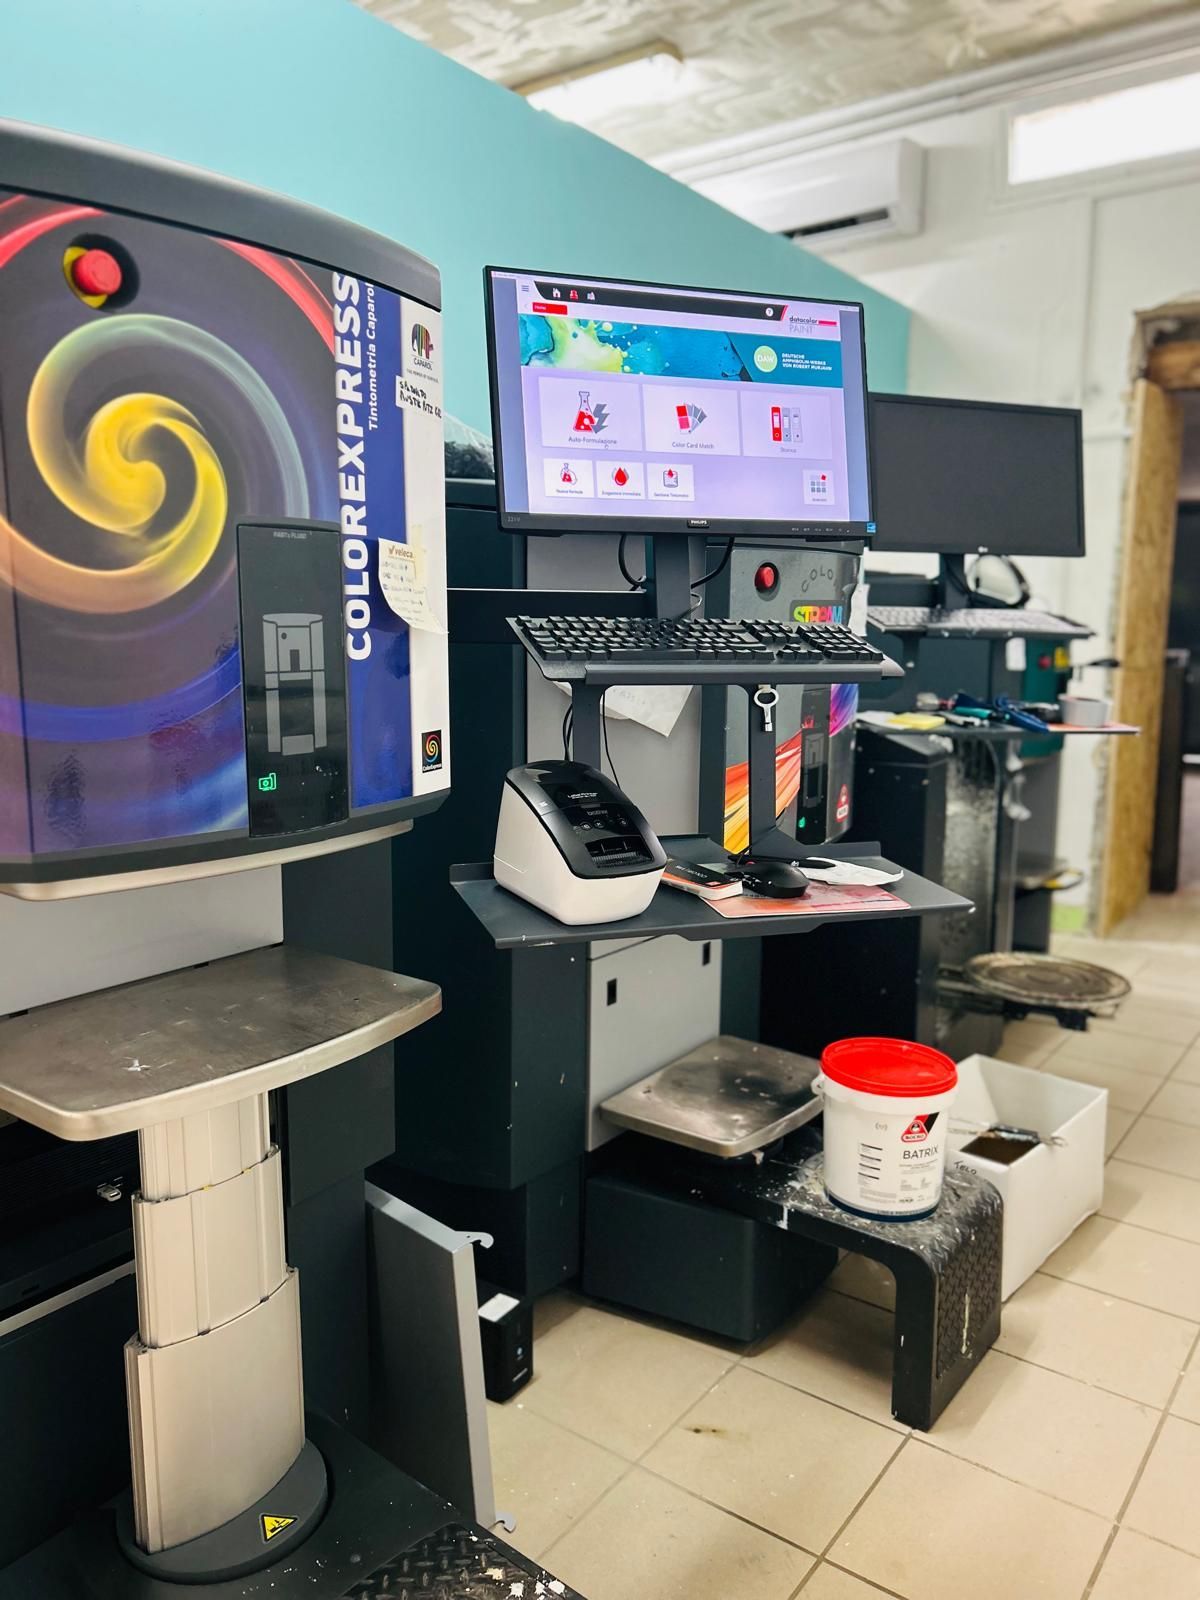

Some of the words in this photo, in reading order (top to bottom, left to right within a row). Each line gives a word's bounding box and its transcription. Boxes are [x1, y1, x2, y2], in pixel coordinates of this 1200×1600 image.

[789, 316, 818, 324] datacolor
[789, 325, 813, 334] PAINT
[414, 358, 433, 370] CAPAROL
[365, 343, 378, 431] Tintometria
[332, 271, 372, 661] COLOREXPRESS
[903, 1146, 938, 1159] BATRIX
[954, 1160, 977, 1175] TELO
